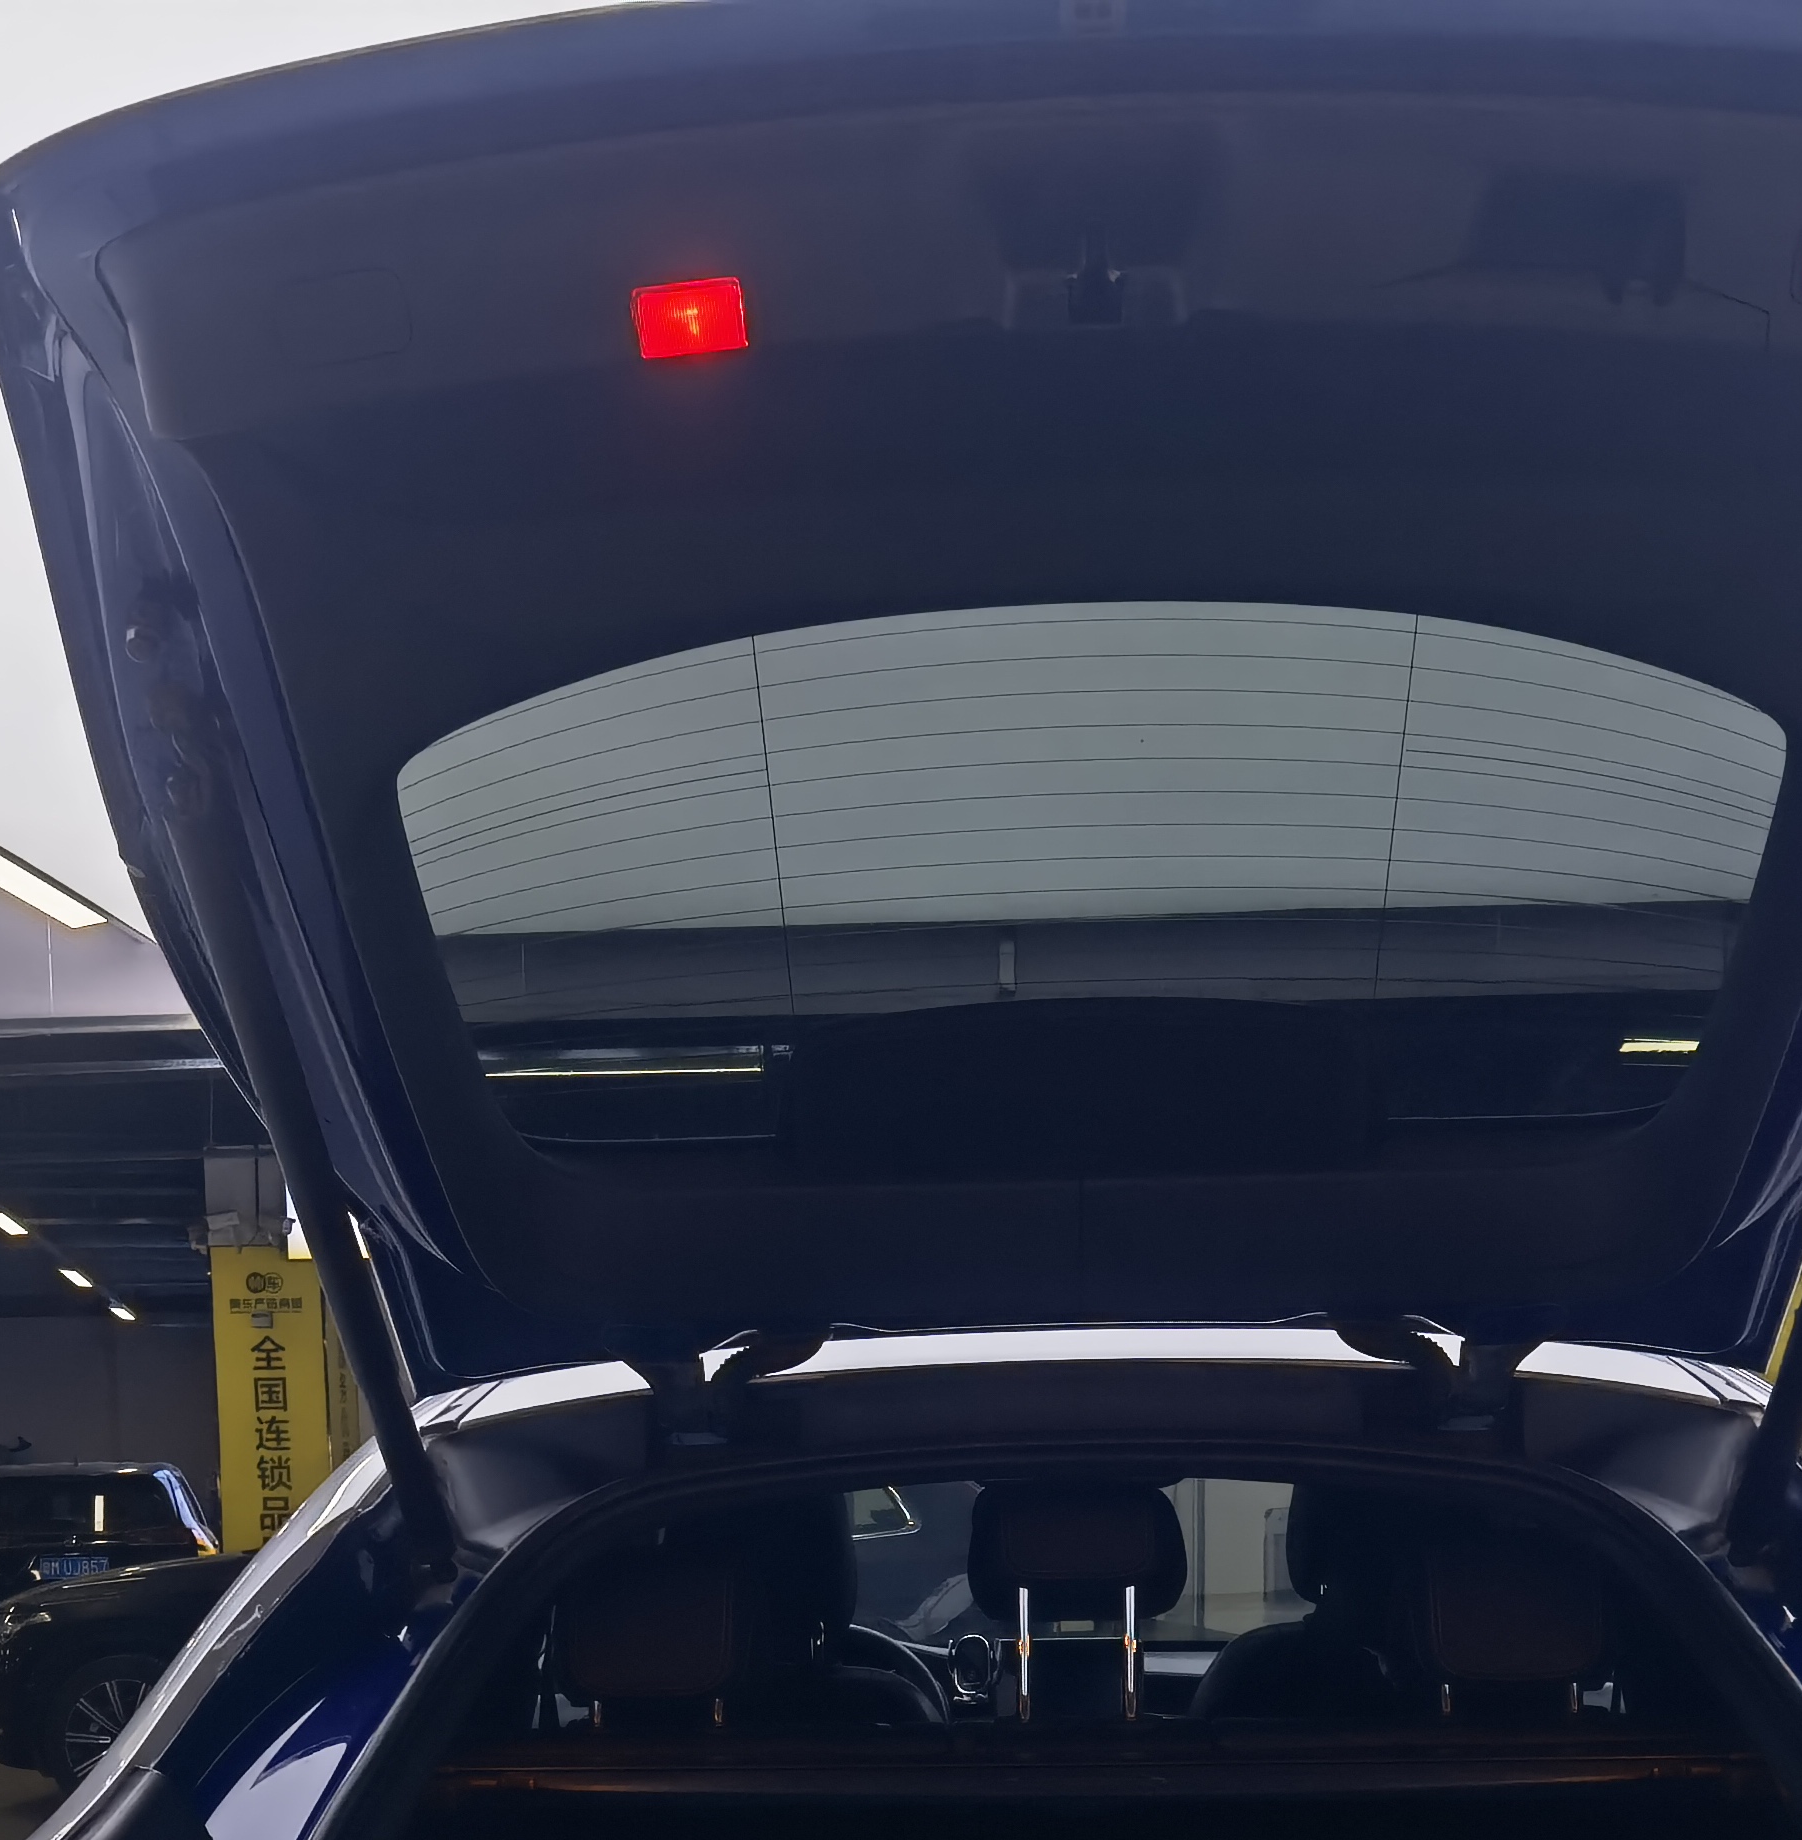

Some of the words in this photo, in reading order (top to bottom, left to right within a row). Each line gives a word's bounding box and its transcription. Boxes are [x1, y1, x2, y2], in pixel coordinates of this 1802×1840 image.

[250, 1335, 293, 1546] 全国连锁品
